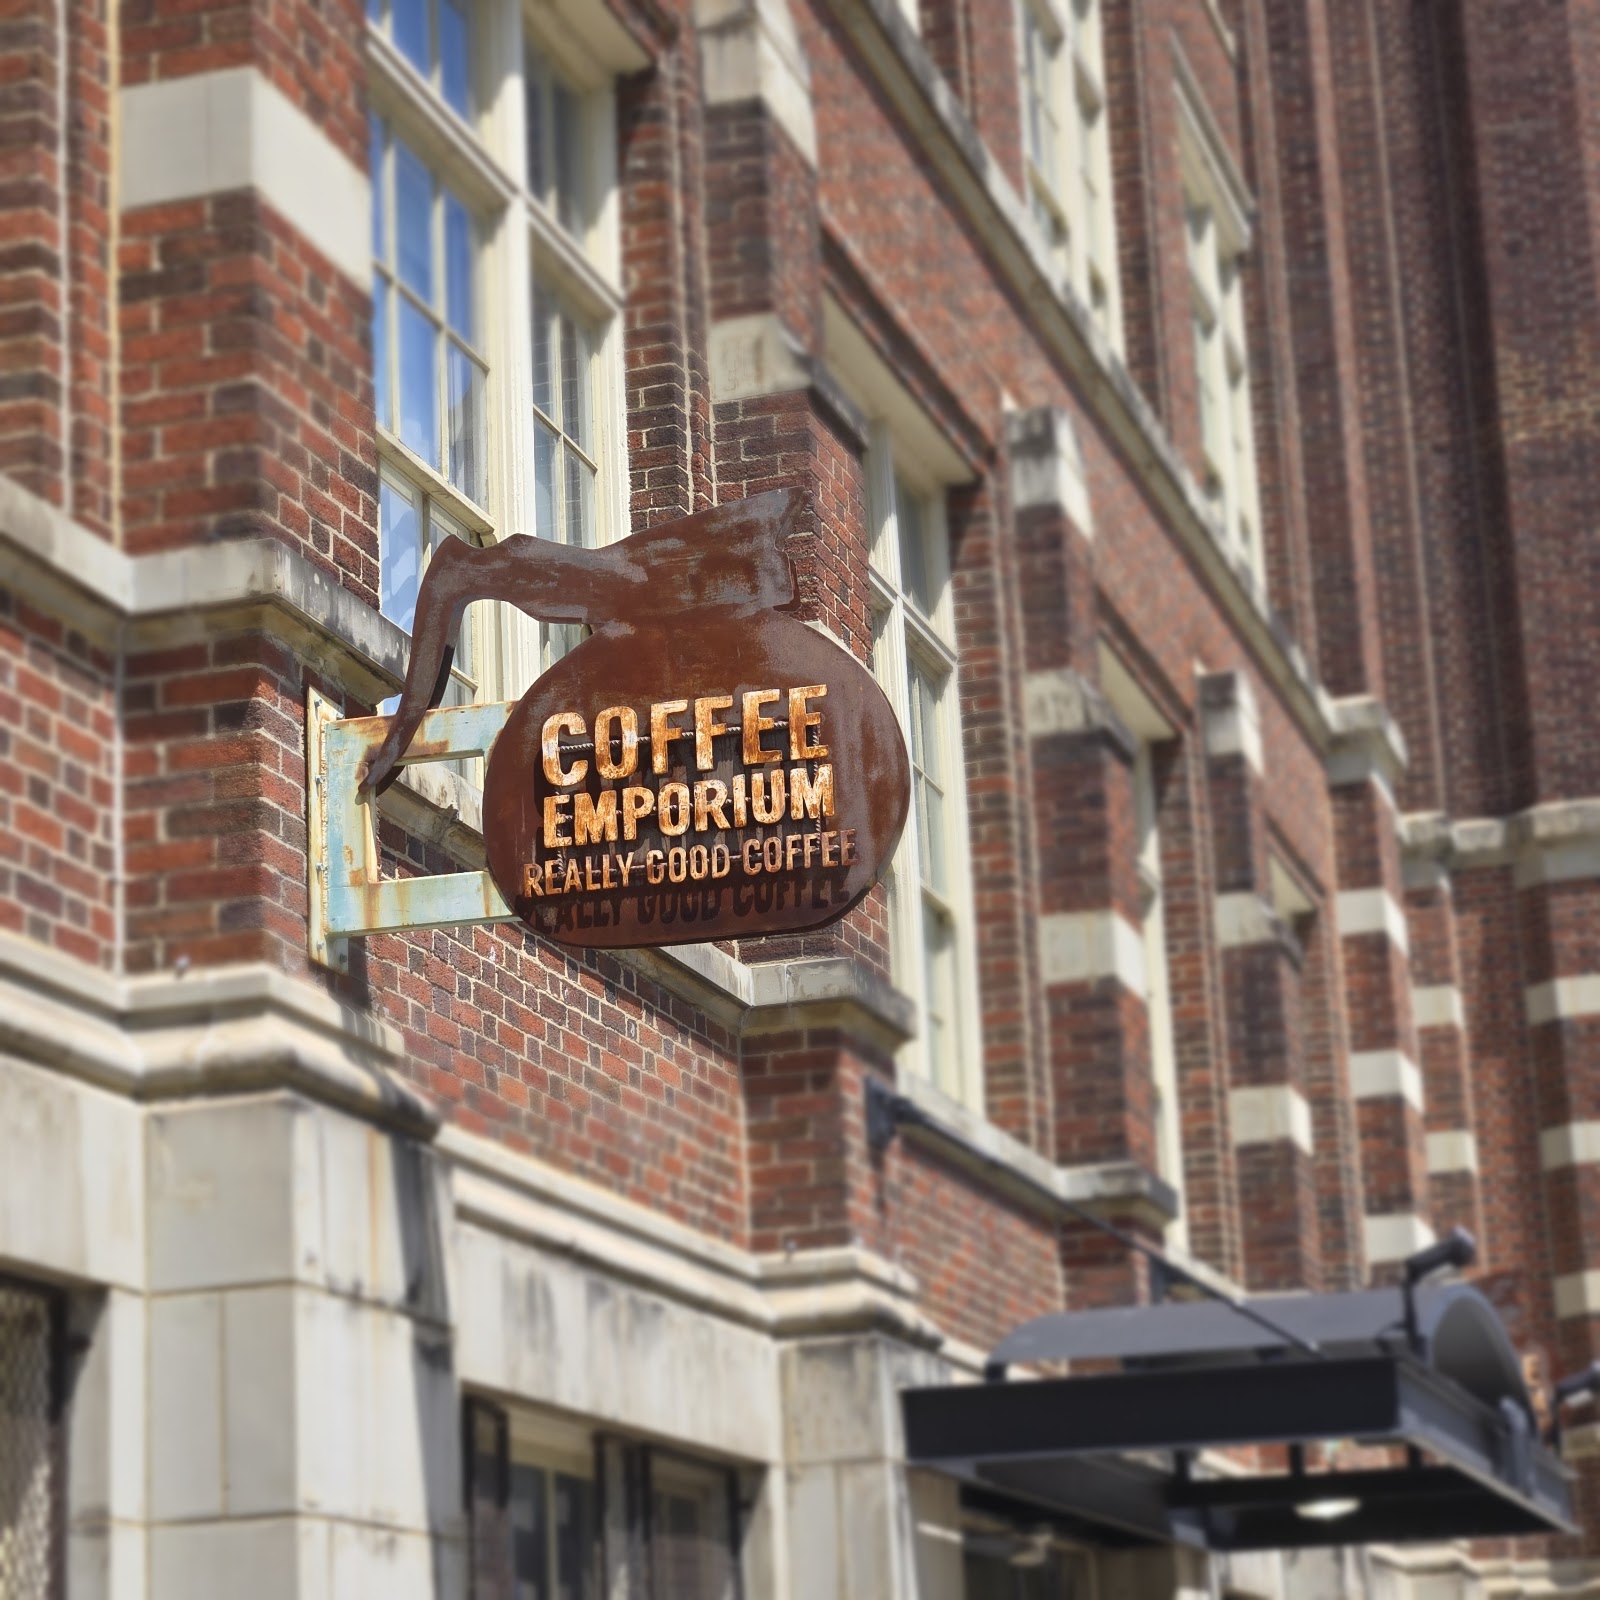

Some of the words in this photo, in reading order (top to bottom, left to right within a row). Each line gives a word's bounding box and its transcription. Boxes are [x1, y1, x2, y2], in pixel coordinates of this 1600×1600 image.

[541, 684, 829, 787] COFFEE
[543, 763, 835, 849] EMPORIUM
[523, 851, 634, 898] REALLY
[646, 843, 730, 885] GOOD
[742, 828, 859, 874] COFFEE
